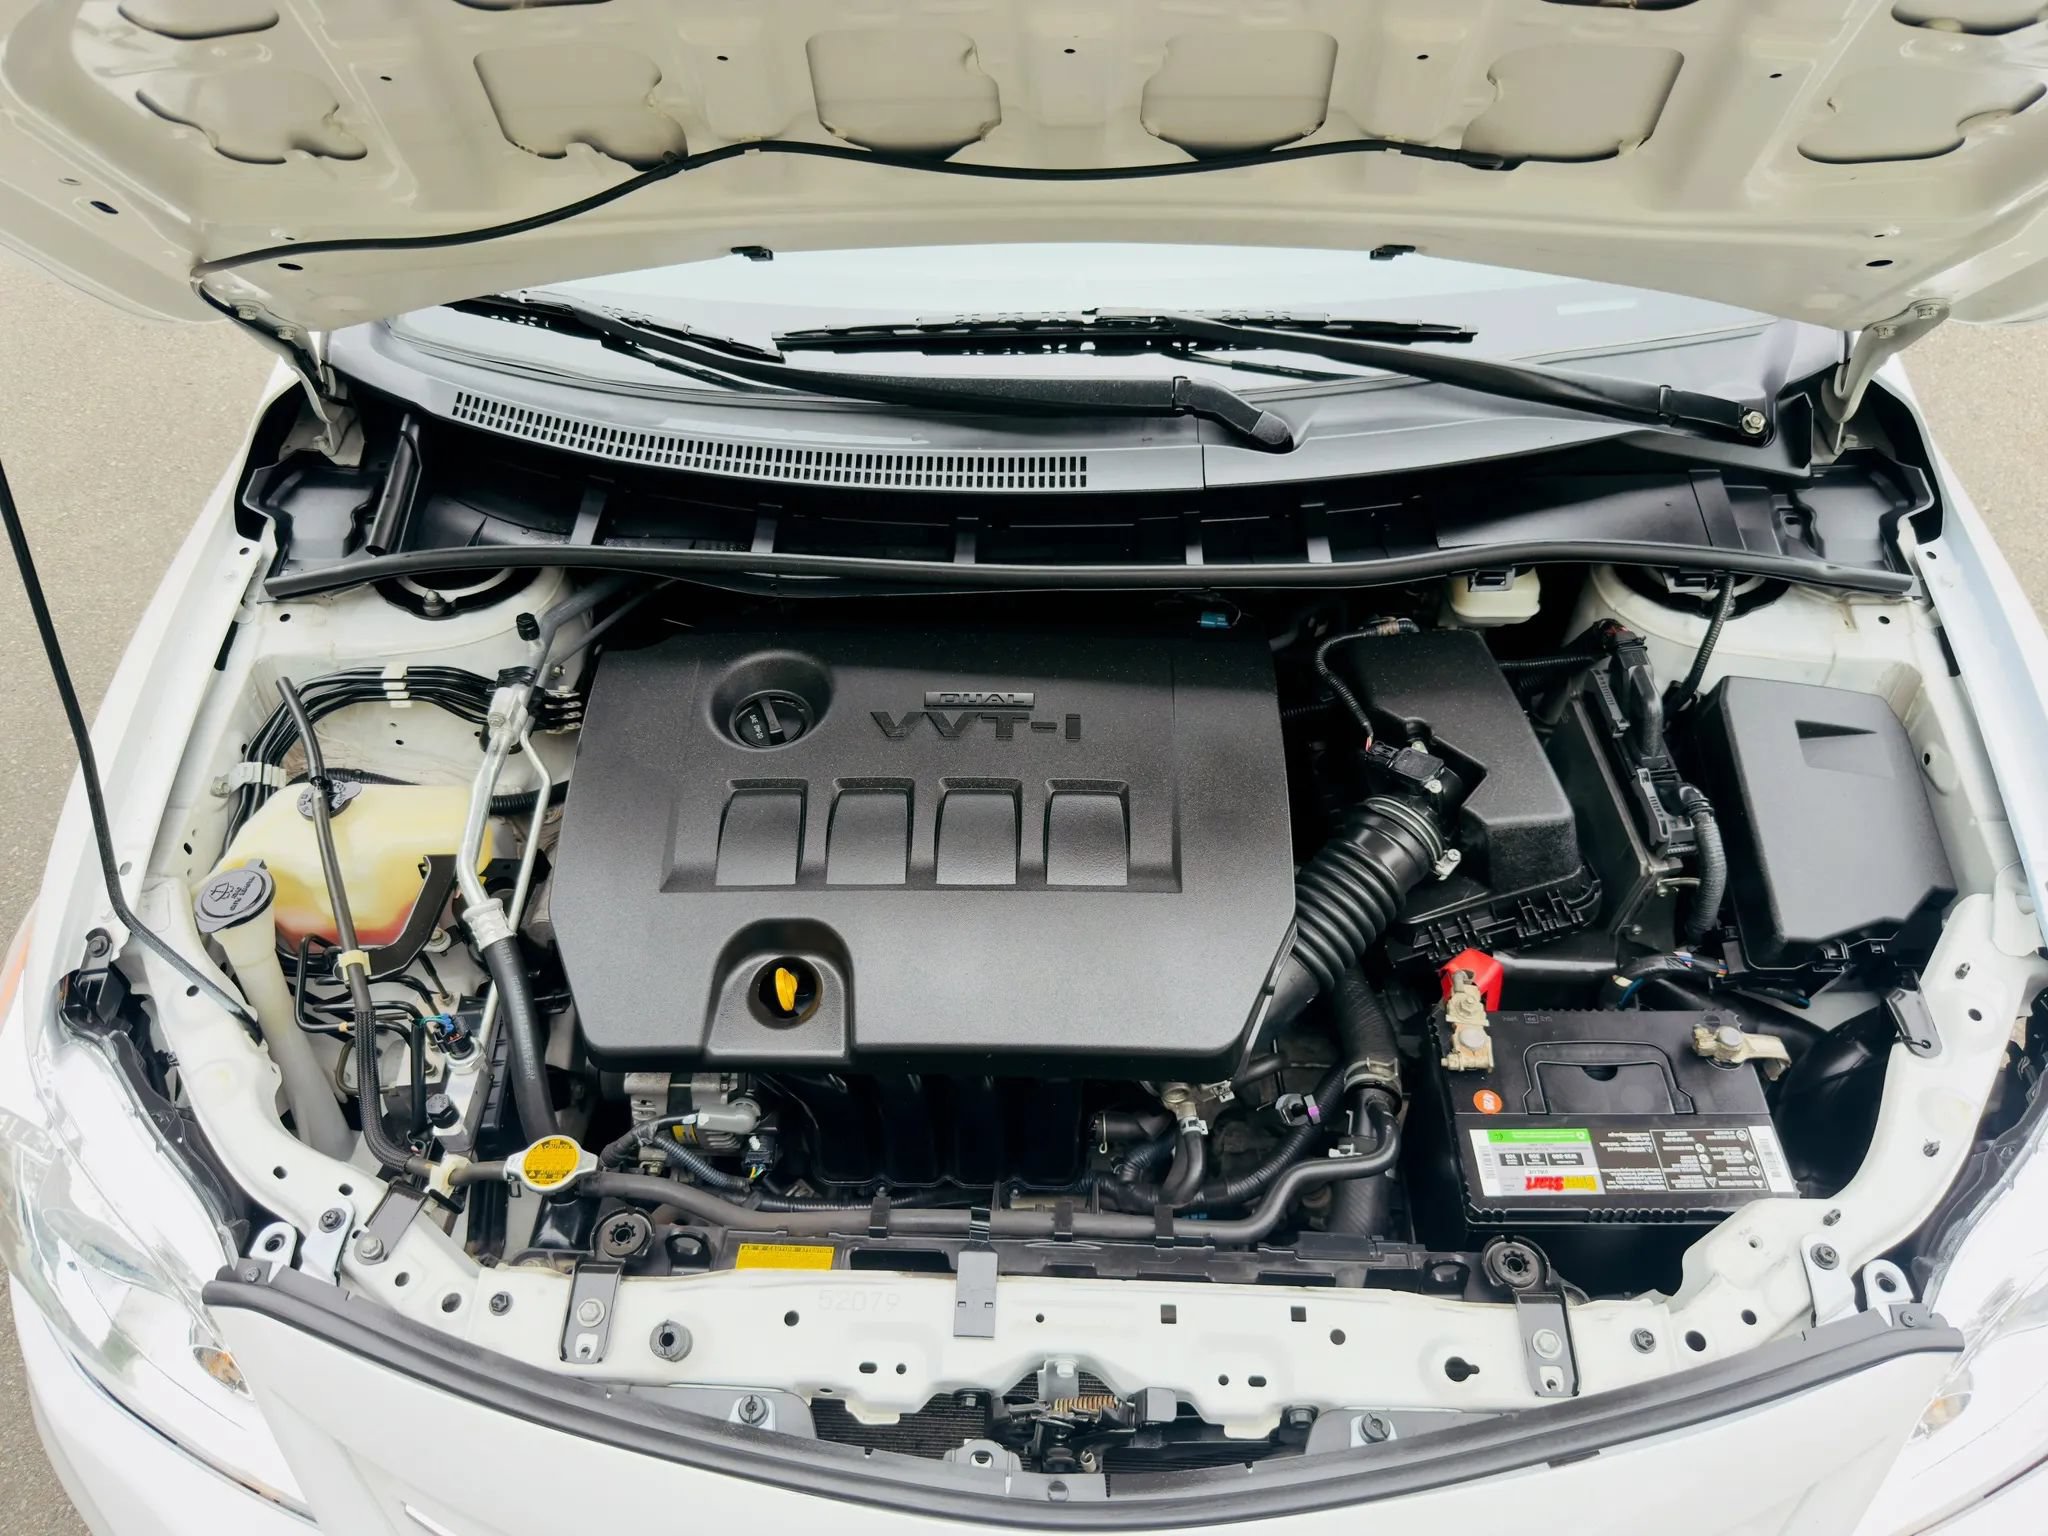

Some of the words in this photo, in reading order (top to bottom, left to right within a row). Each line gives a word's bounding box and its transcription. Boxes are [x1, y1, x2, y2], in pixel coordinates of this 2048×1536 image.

[938, 693, 1025, 704] DUAL
[1525, 1175, 1597, 1193] Start
[817, 1288, 902, 1313] 52079
